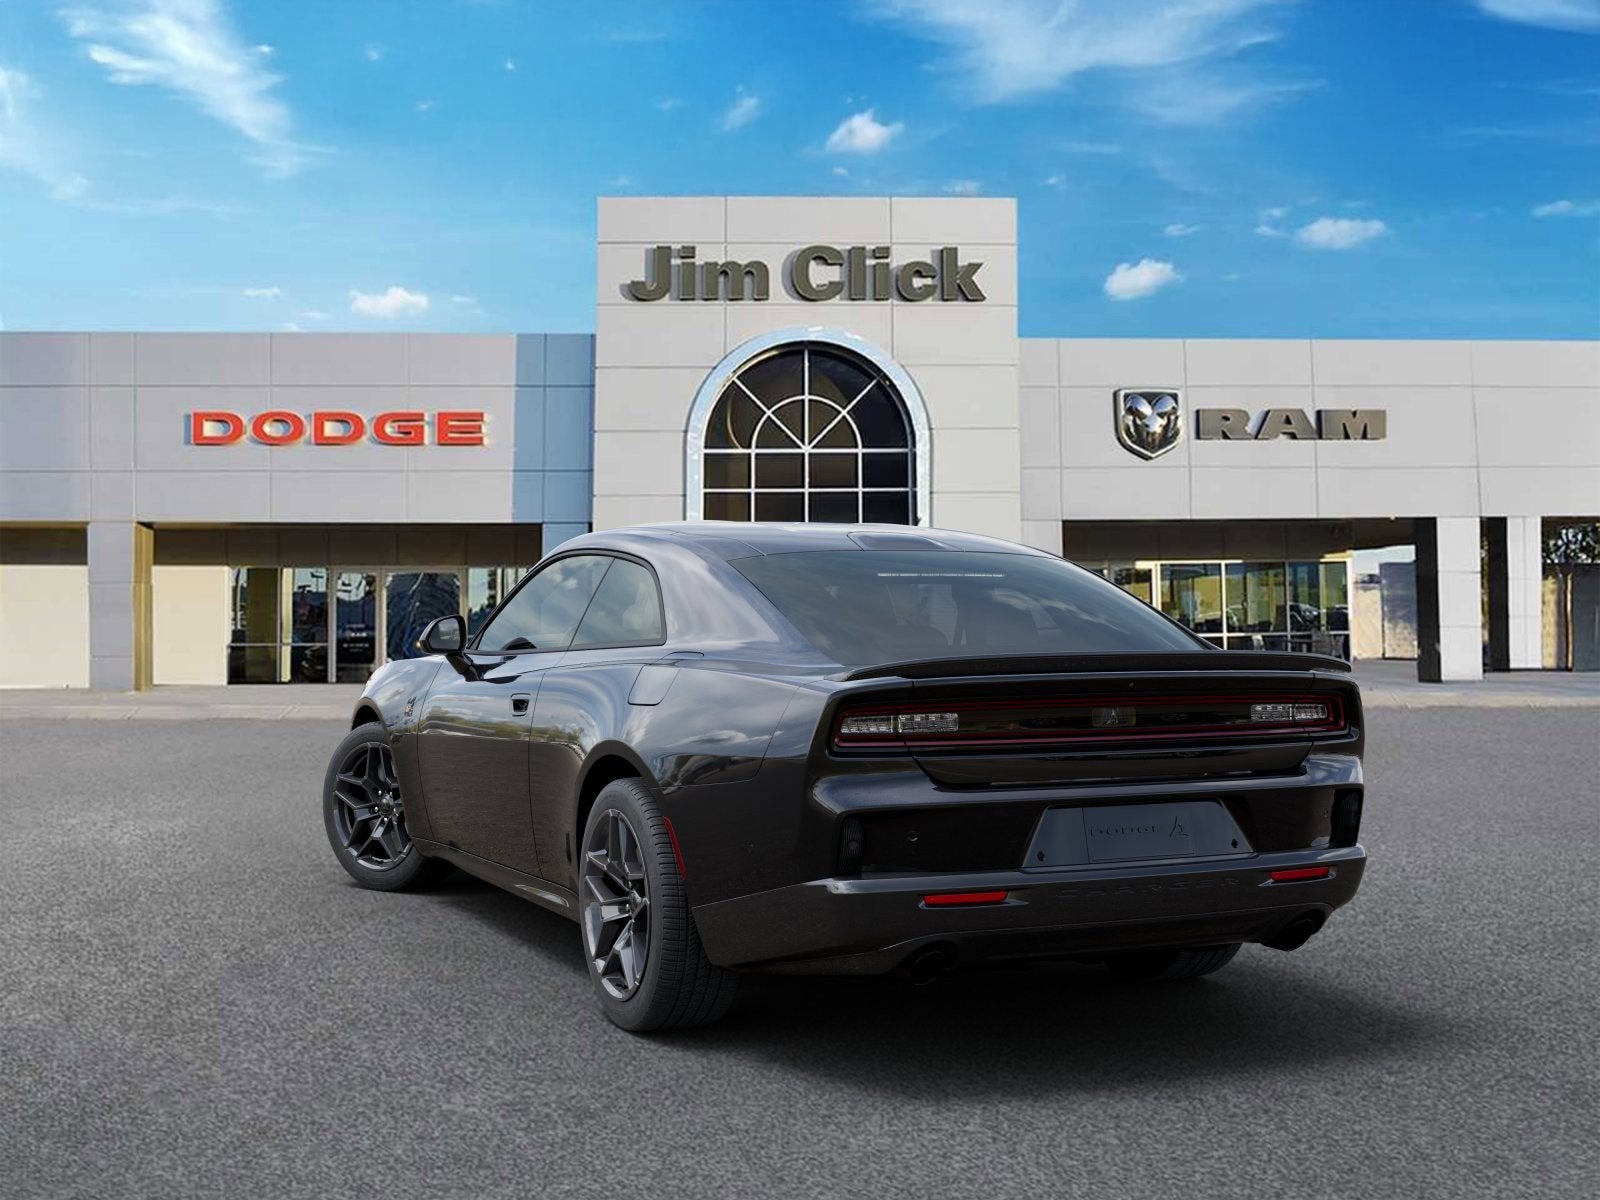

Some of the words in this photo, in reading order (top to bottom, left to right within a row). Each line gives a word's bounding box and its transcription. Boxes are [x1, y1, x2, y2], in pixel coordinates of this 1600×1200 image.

[626, 245, 770, 301] Jim
[790, 245, 986, 301] Click
[190, 410, 487, 447] DODGE
[1195, 408, 1388, 441] RAM
